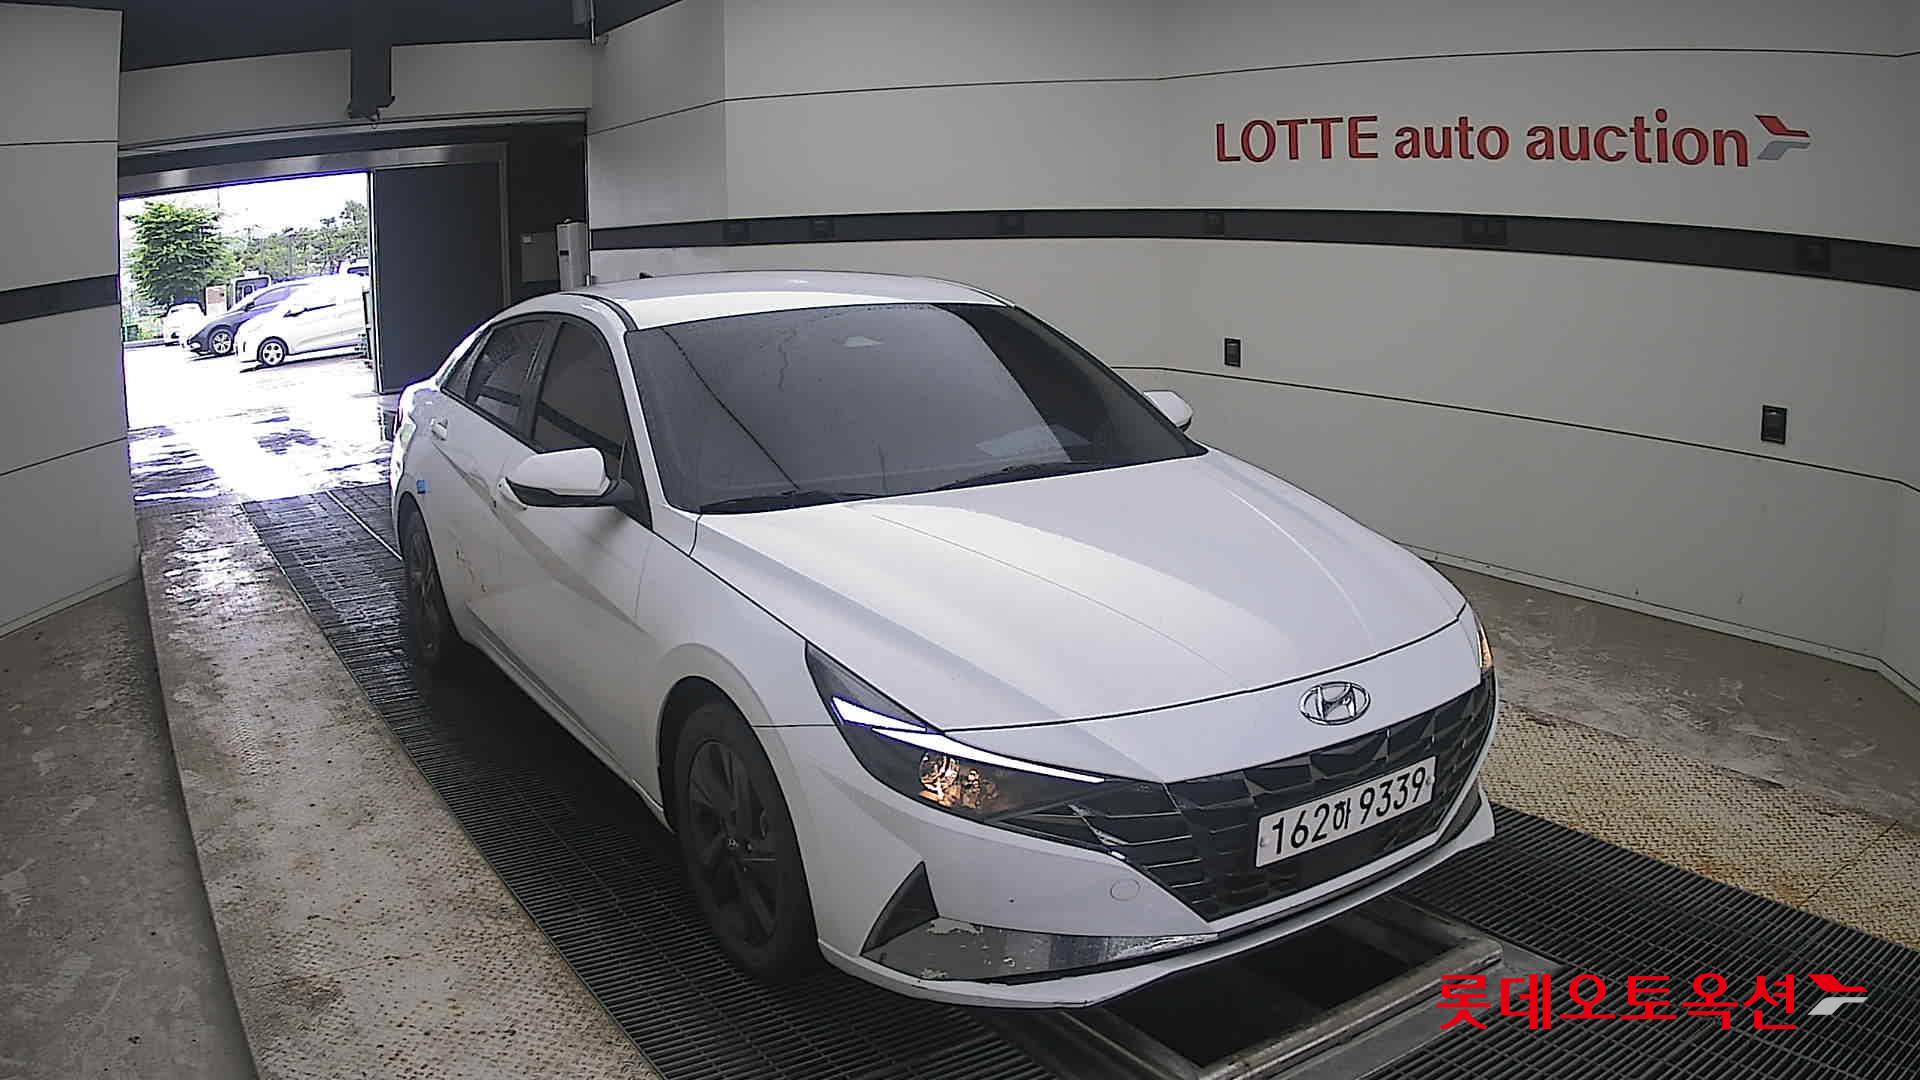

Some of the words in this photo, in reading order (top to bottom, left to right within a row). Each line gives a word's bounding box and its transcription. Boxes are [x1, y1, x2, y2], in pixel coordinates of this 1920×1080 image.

[1215, 115, 1379, 163] LOTTE
[1394, 116, 1511, 160] auto
[1526, 108, 1750, 168] auction
[1359, 766, 1427, 825] 9339
